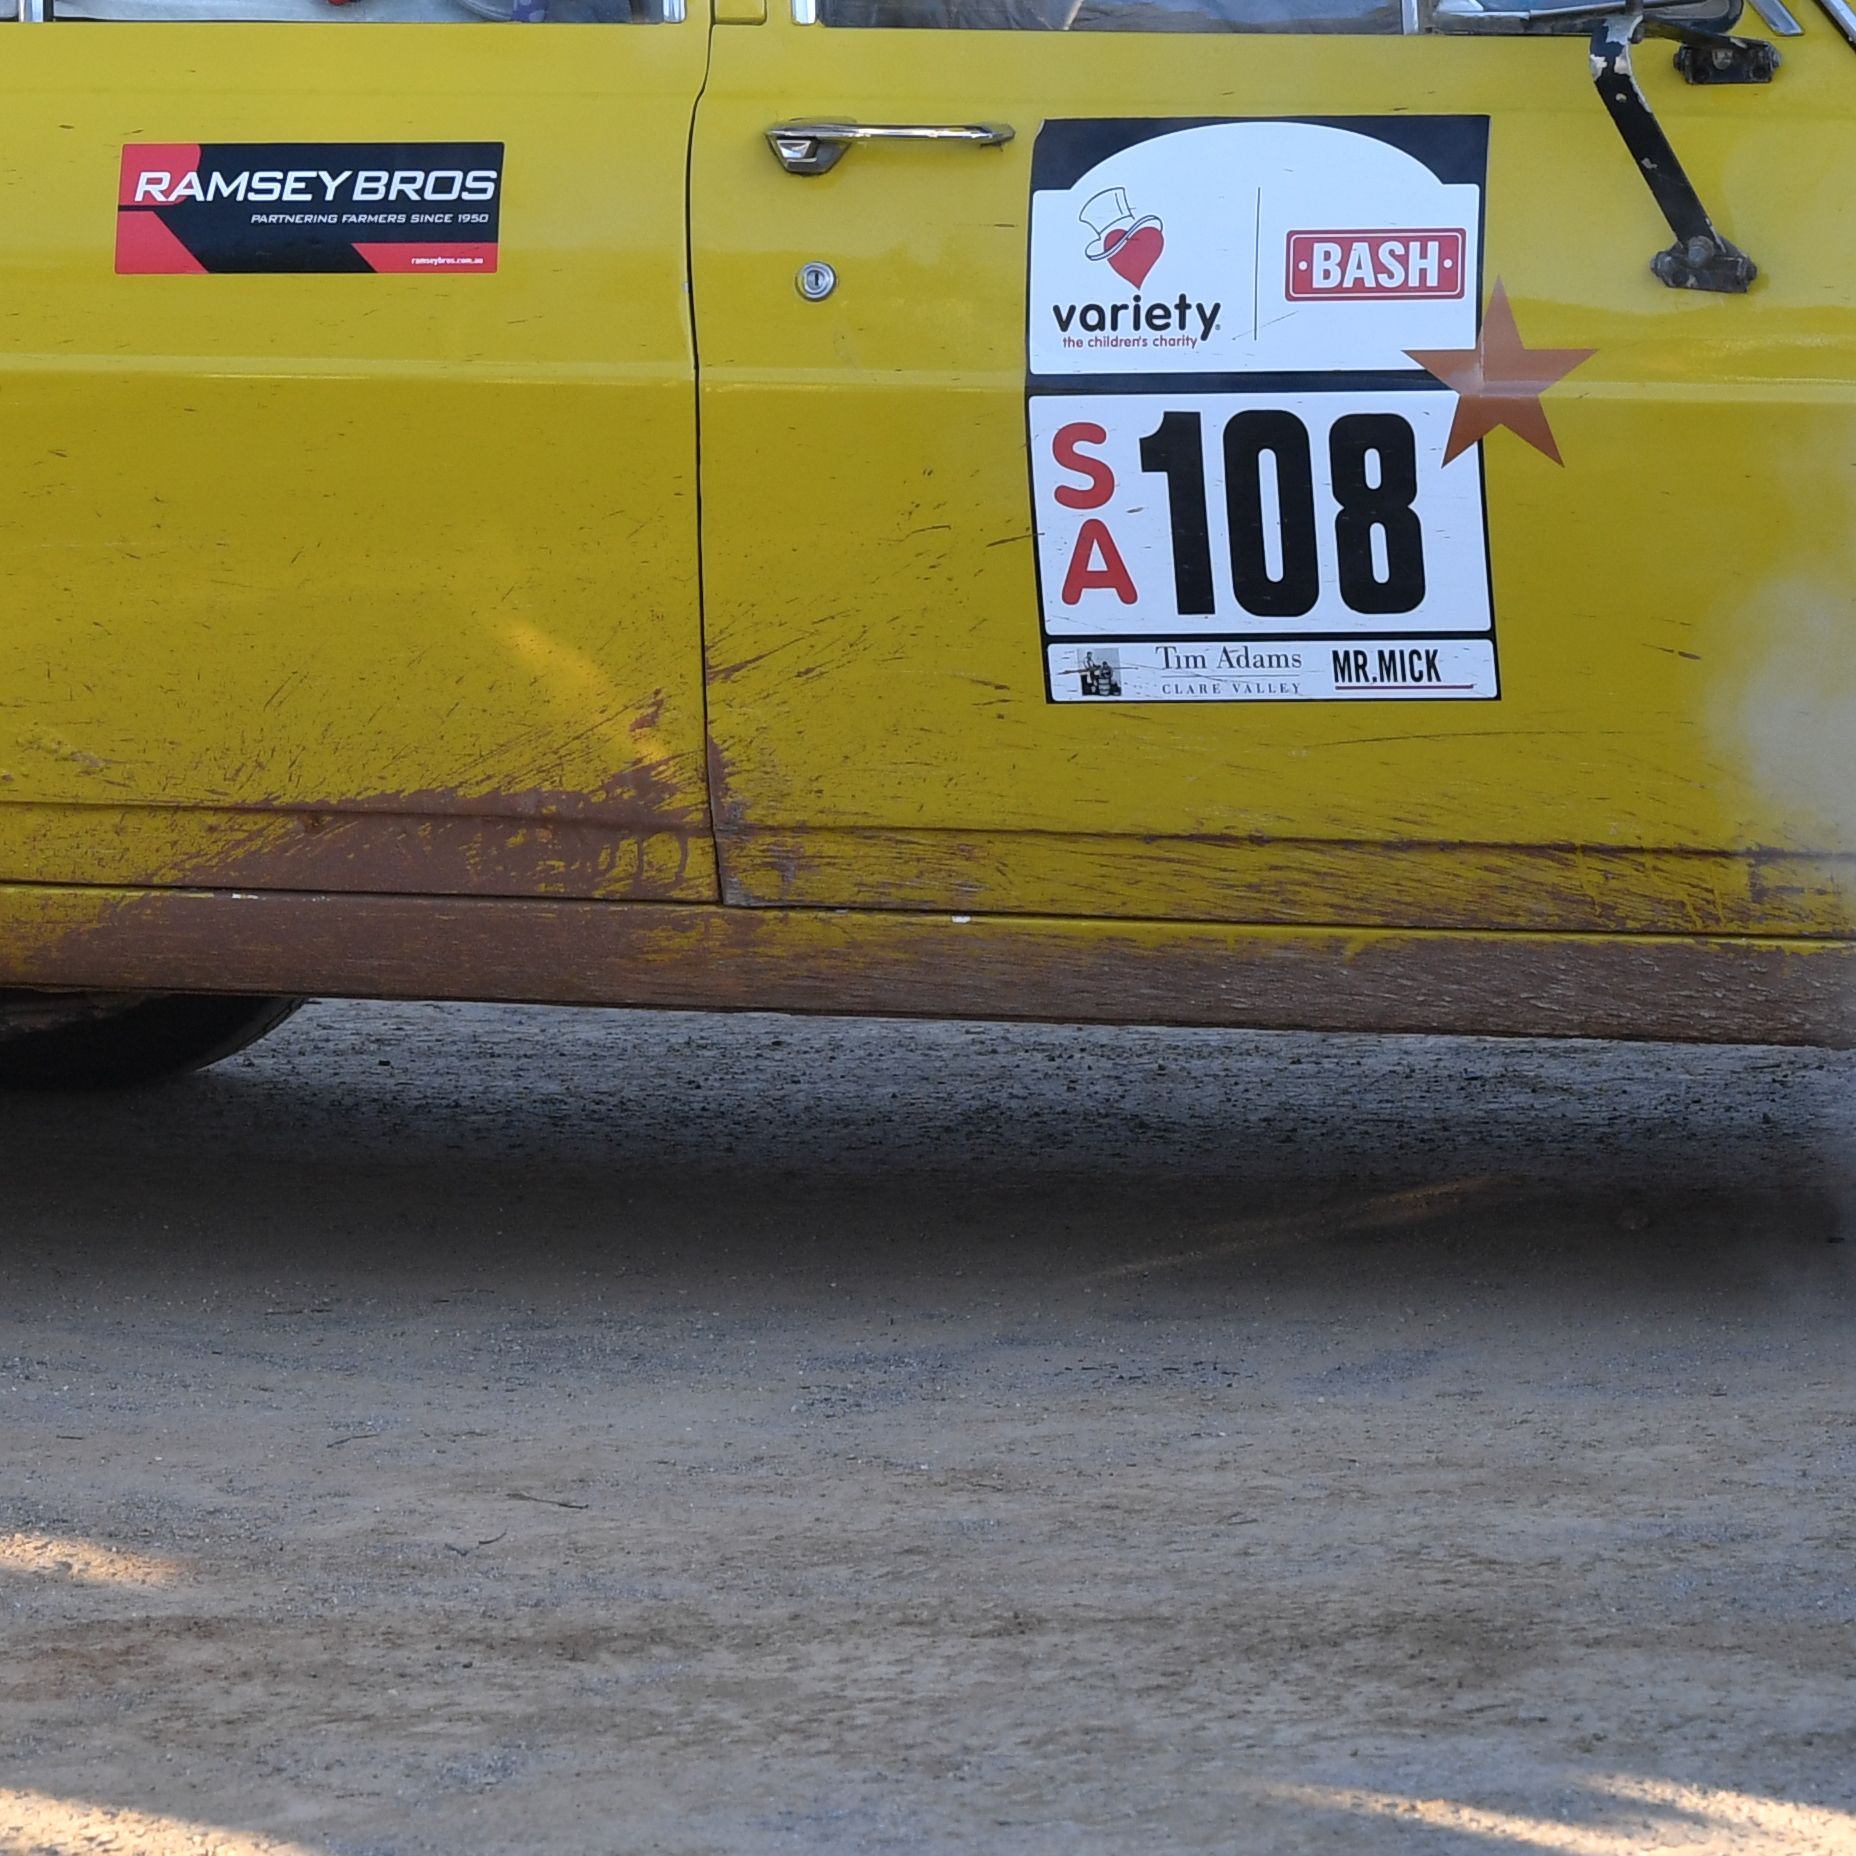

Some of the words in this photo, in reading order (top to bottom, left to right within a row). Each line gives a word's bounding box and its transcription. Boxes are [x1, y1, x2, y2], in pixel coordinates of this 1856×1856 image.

[250, 213, 338, 224] PARTNERING
[341, 213, 406, 224] FARMERS
[410, 213, 454, 223] SINCE
[457, 213, 489, 223] 1950
[1311, 240, 1440, 289] BASH
[1051, 293, 1221, 342] variety
[1062, 335, 1084, 349] the
[1087, 334, 1148, 349] children's
[1152, 334, 1198, 350] charity
[1138, 409, 1427, 617] 108
[1155, 646, 1208, 671] Tim
[1215, 645, 1304, 670] Adams
[1331, 648, 1442, 685] MR.MICK
[1162, 682, 1221, 695] CLARE
[1232, 682, 1302, 695] VALLEY
